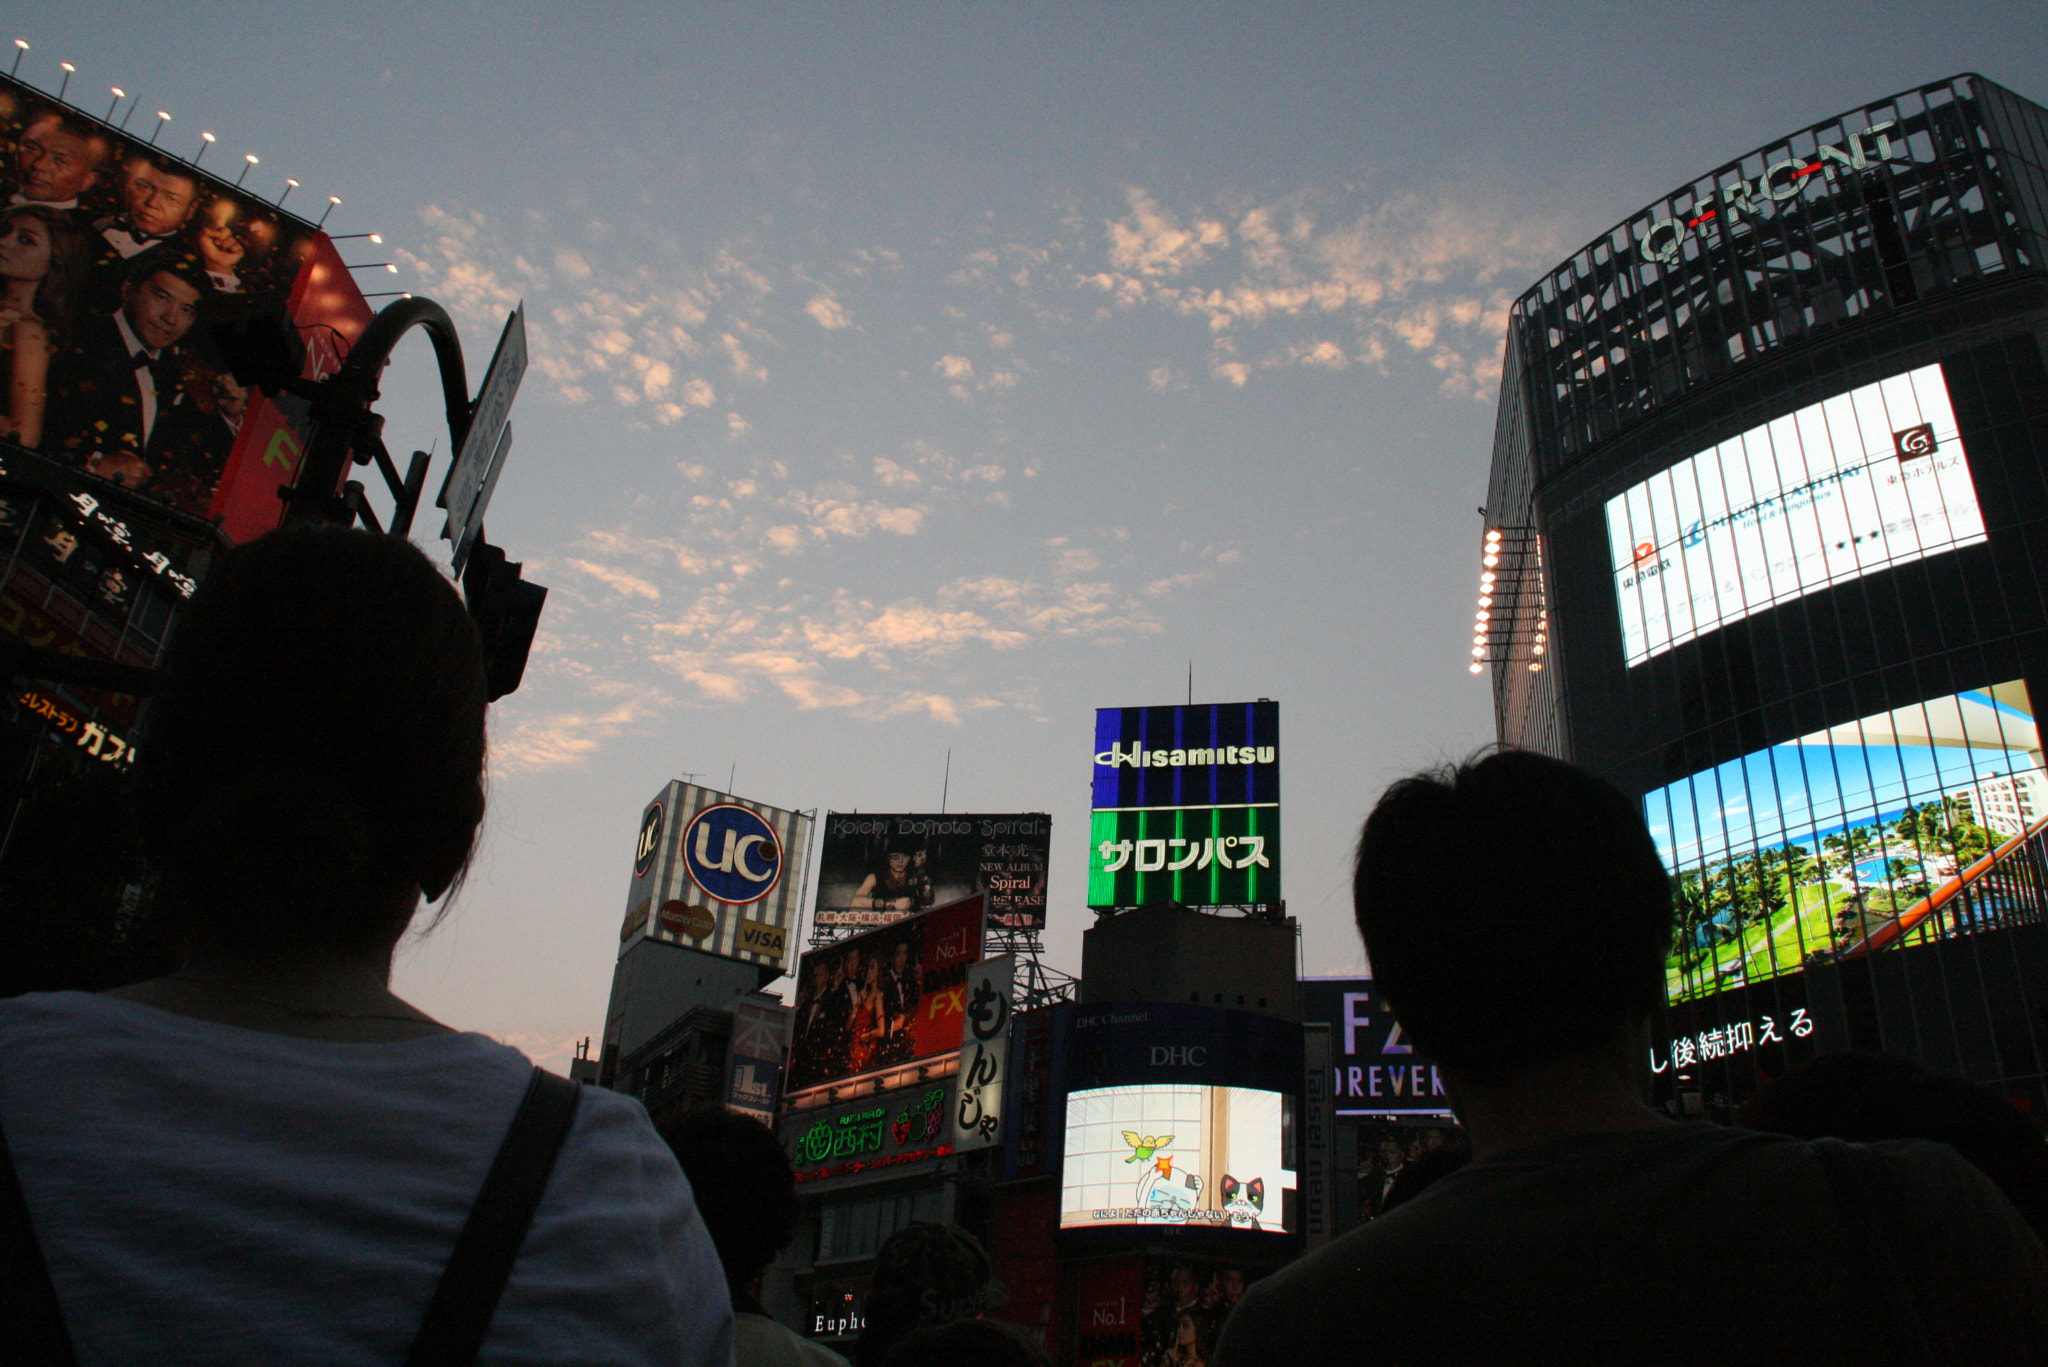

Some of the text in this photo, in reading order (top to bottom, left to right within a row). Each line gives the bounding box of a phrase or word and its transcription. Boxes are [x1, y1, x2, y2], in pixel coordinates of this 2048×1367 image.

[1094, 740, 1275, 768] Hisamitsu
[979, 862, 1043, 872] NEW ALBUM
[1098, 836, 1270, 873] サロンパス
[989, 874, 1031, 891] Spiral
[743, 928, 783, 951] VISA
[935, 926, 969, 962] No.1
[928, 987, 966, 1021] FX
[1076, 1010, 1149, 1029] DHC Channel
[1150, 1046, 1207, 1066] DHC
[1649, 1007, 1816, 1075] し後続抑える
[958, 977, 1007, 1143] もんじゃ
[833, 1120, 885, 1158] 西村
[1092, 1295, 1127, 1328] No.1
